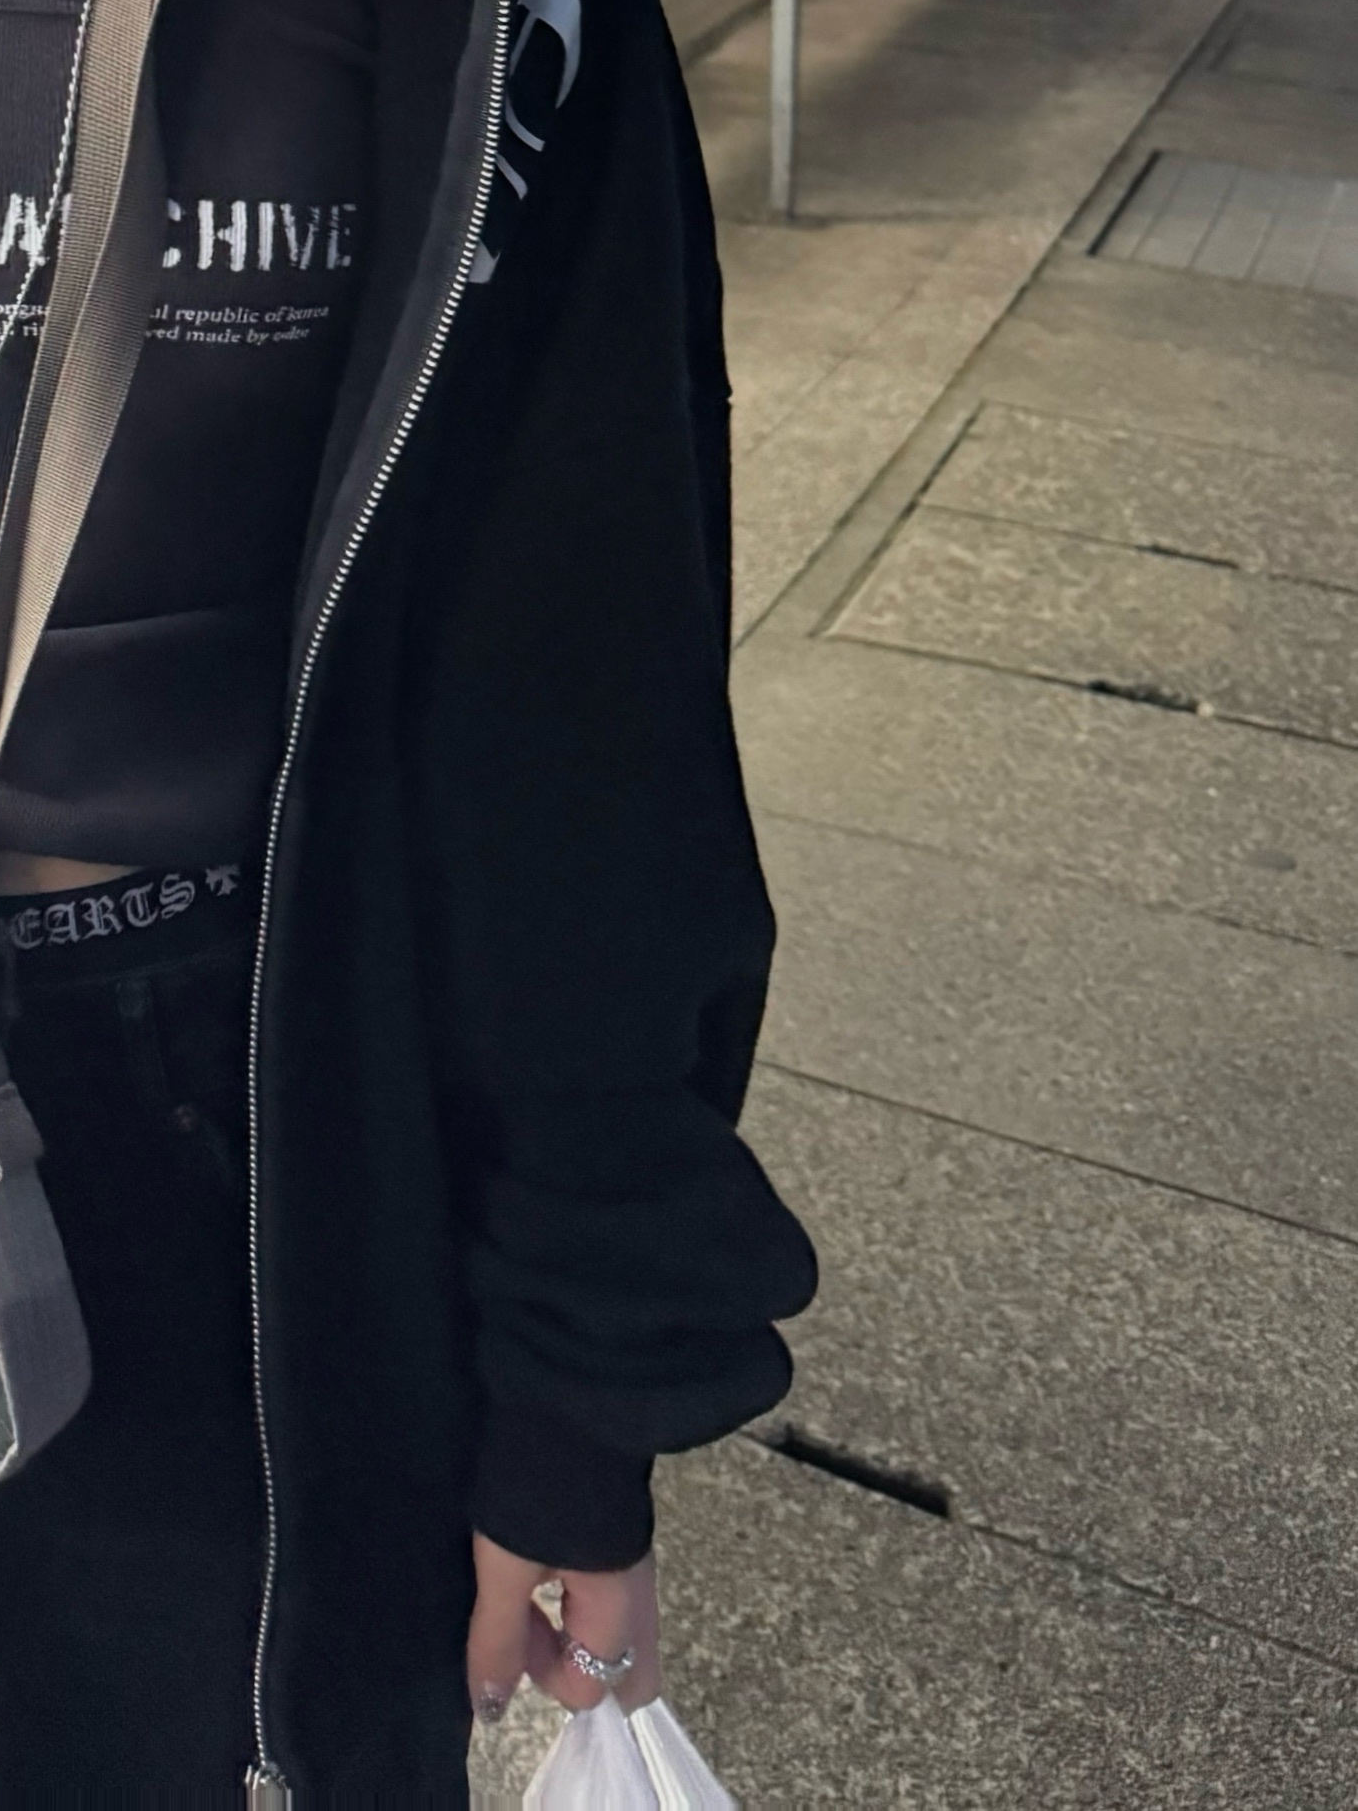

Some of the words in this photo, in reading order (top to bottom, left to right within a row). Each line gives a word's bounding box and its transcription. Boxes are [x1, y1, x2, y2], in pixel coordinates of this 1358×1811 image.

[175, 307, 259, 326] republic
[264, 306, 286, 323] of
[185, 327, 242, 343] made
[246, 329, 270, 346] by
